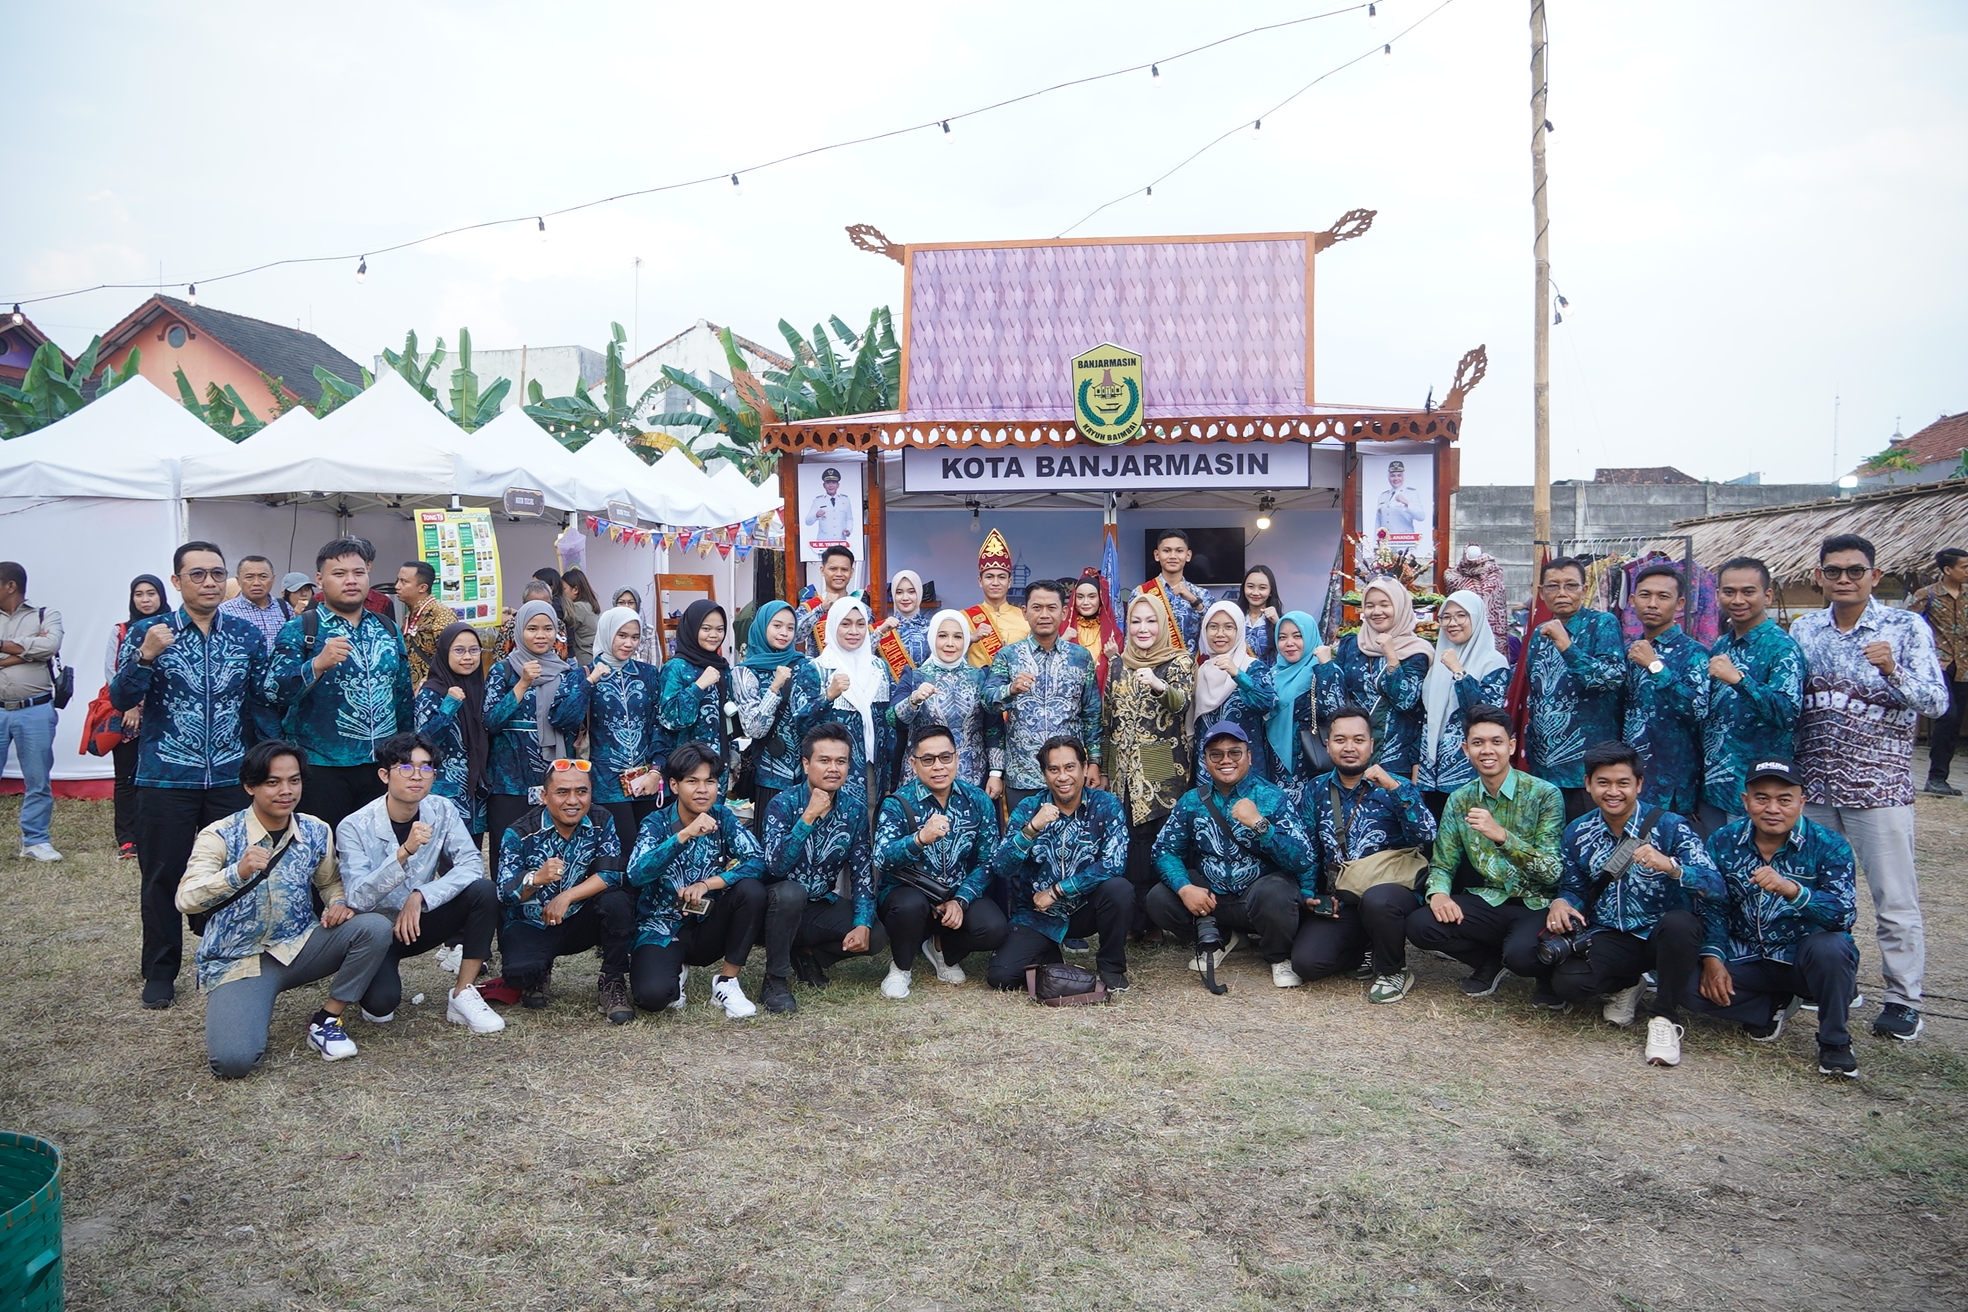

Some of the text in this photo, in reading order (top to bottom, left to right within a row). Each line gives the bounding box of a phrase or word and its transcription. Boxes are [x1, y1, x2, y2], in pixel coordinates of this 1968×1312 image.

[1077, 357, 1137, 370] BANJARMASIN
[1082, 421, 1138, 442] KAYUH BAIMBAI
[942, 453, 1269, 479] KOTA BANJARMASIN
[881, 639, 902, 663] GALUH
